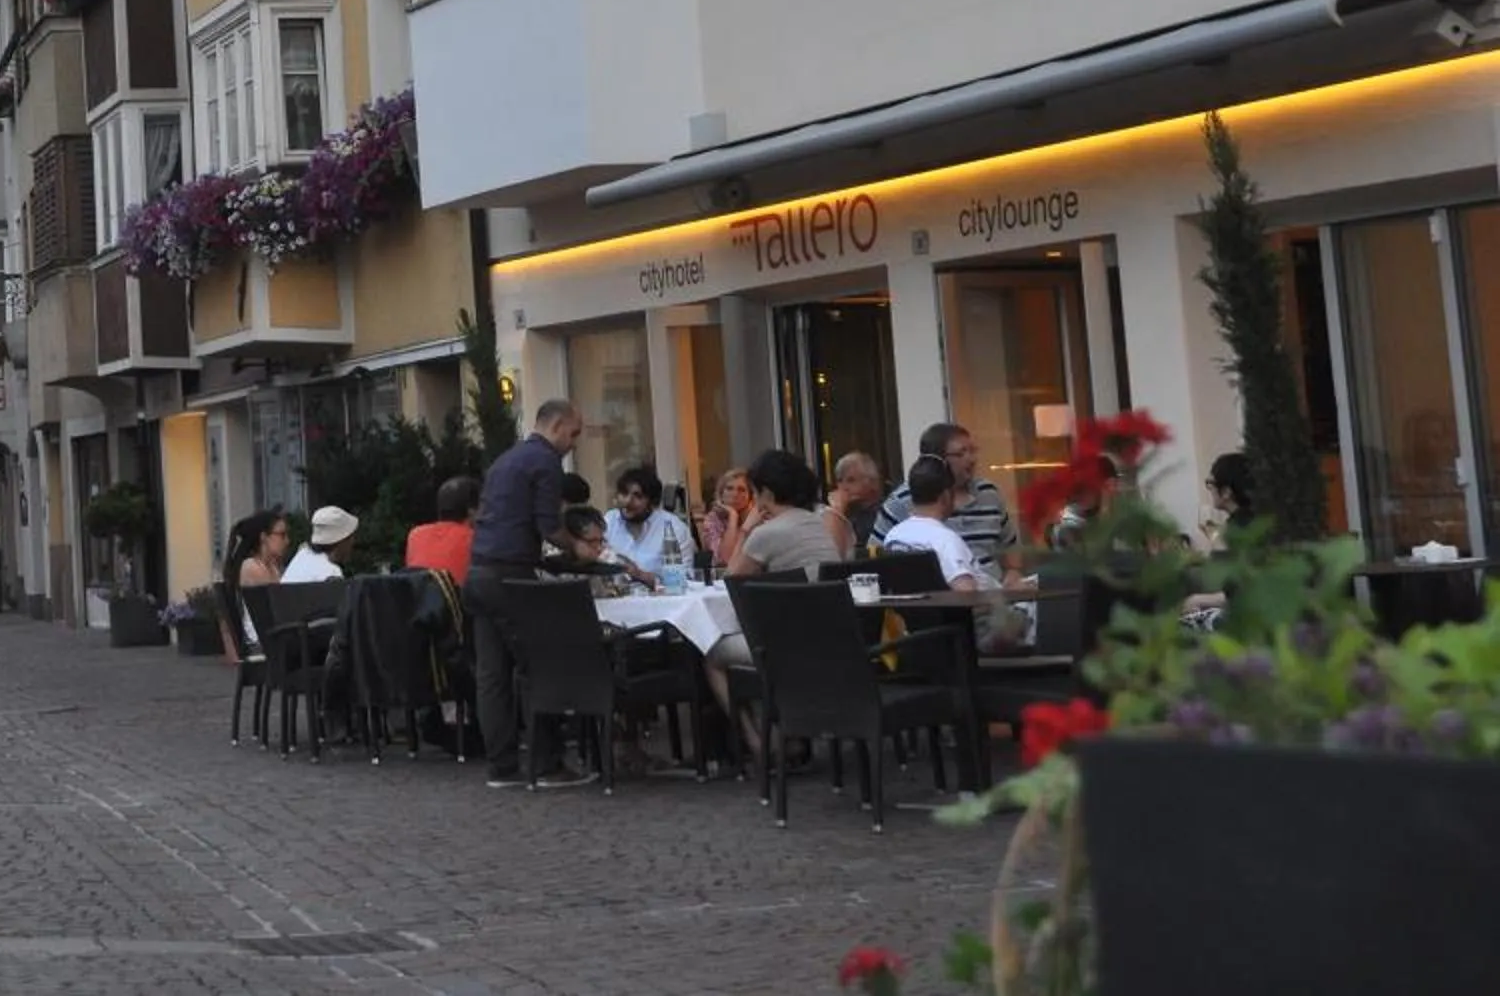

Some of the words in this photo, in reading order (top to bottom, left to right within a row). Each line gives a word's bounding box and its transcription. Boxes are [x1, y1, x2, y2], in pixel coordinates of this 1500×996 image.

[728, 193, 878, 273] Tallero
[958, 190, 1080, 243] citylounge
[638, 252, 705, 298] cityhotel
